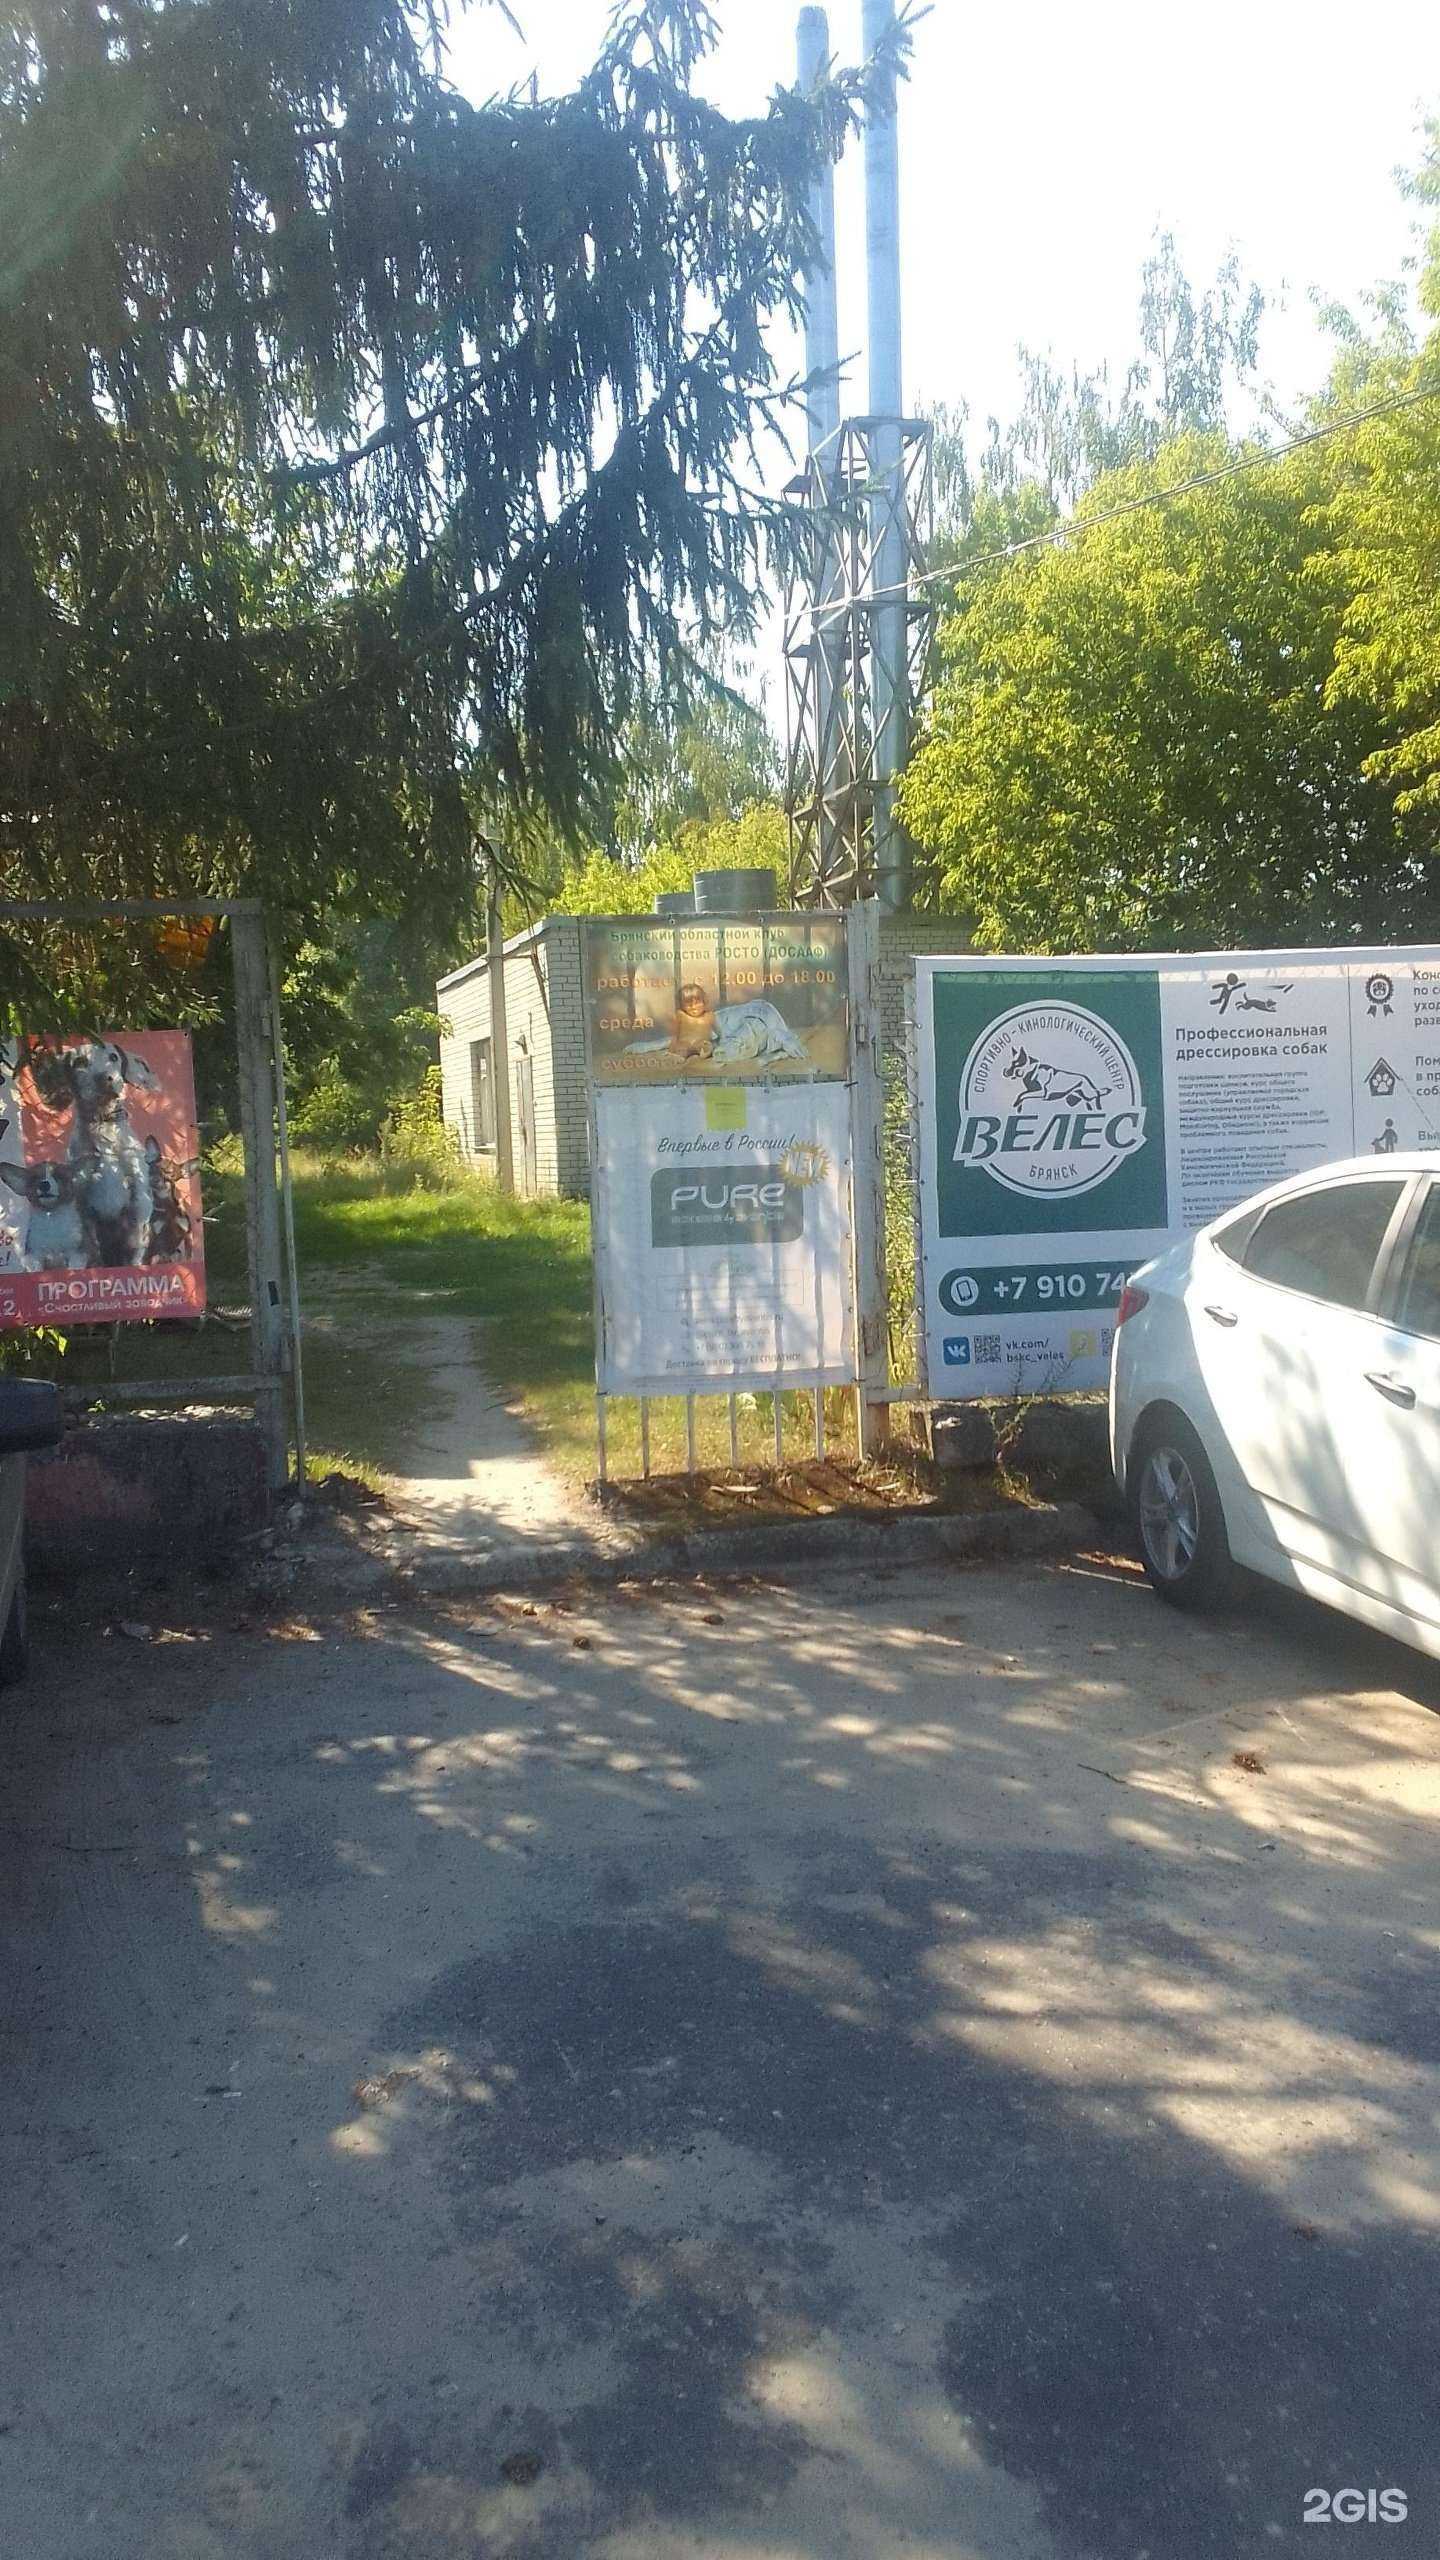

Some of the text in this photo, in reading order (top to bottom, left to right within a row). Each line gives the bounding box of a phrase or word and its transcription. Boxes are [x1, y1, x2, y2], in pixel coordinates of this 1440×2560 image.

[681, 930, 753, 942] областной
[715, 947, 759, 959] РОСТО
[1414, 987, 1429, 996] по
[600, 1016, 655, 1030] среда
[1176, 1026, 1328, 1043] Профессиональная
[1176, 1042, 1328, 1061] дрессировка собак
[1104, 1055, 1126, 1091] ЦЕНТР
[657, 1133, 795, 1157] Впервые в России!
[961, 1112, 1139, 1160] ВЕЛЕС
[1029, 1163, 1078, 1181] БРЯНСК
[671, 1183, 786, 1210] PURE
[38, 1275, 185, 1301] ПРОГРАММА
[994, 1272, 1132, 1300] +7 910 74
[1006, 1338, 1049, 1351] vk.com/
